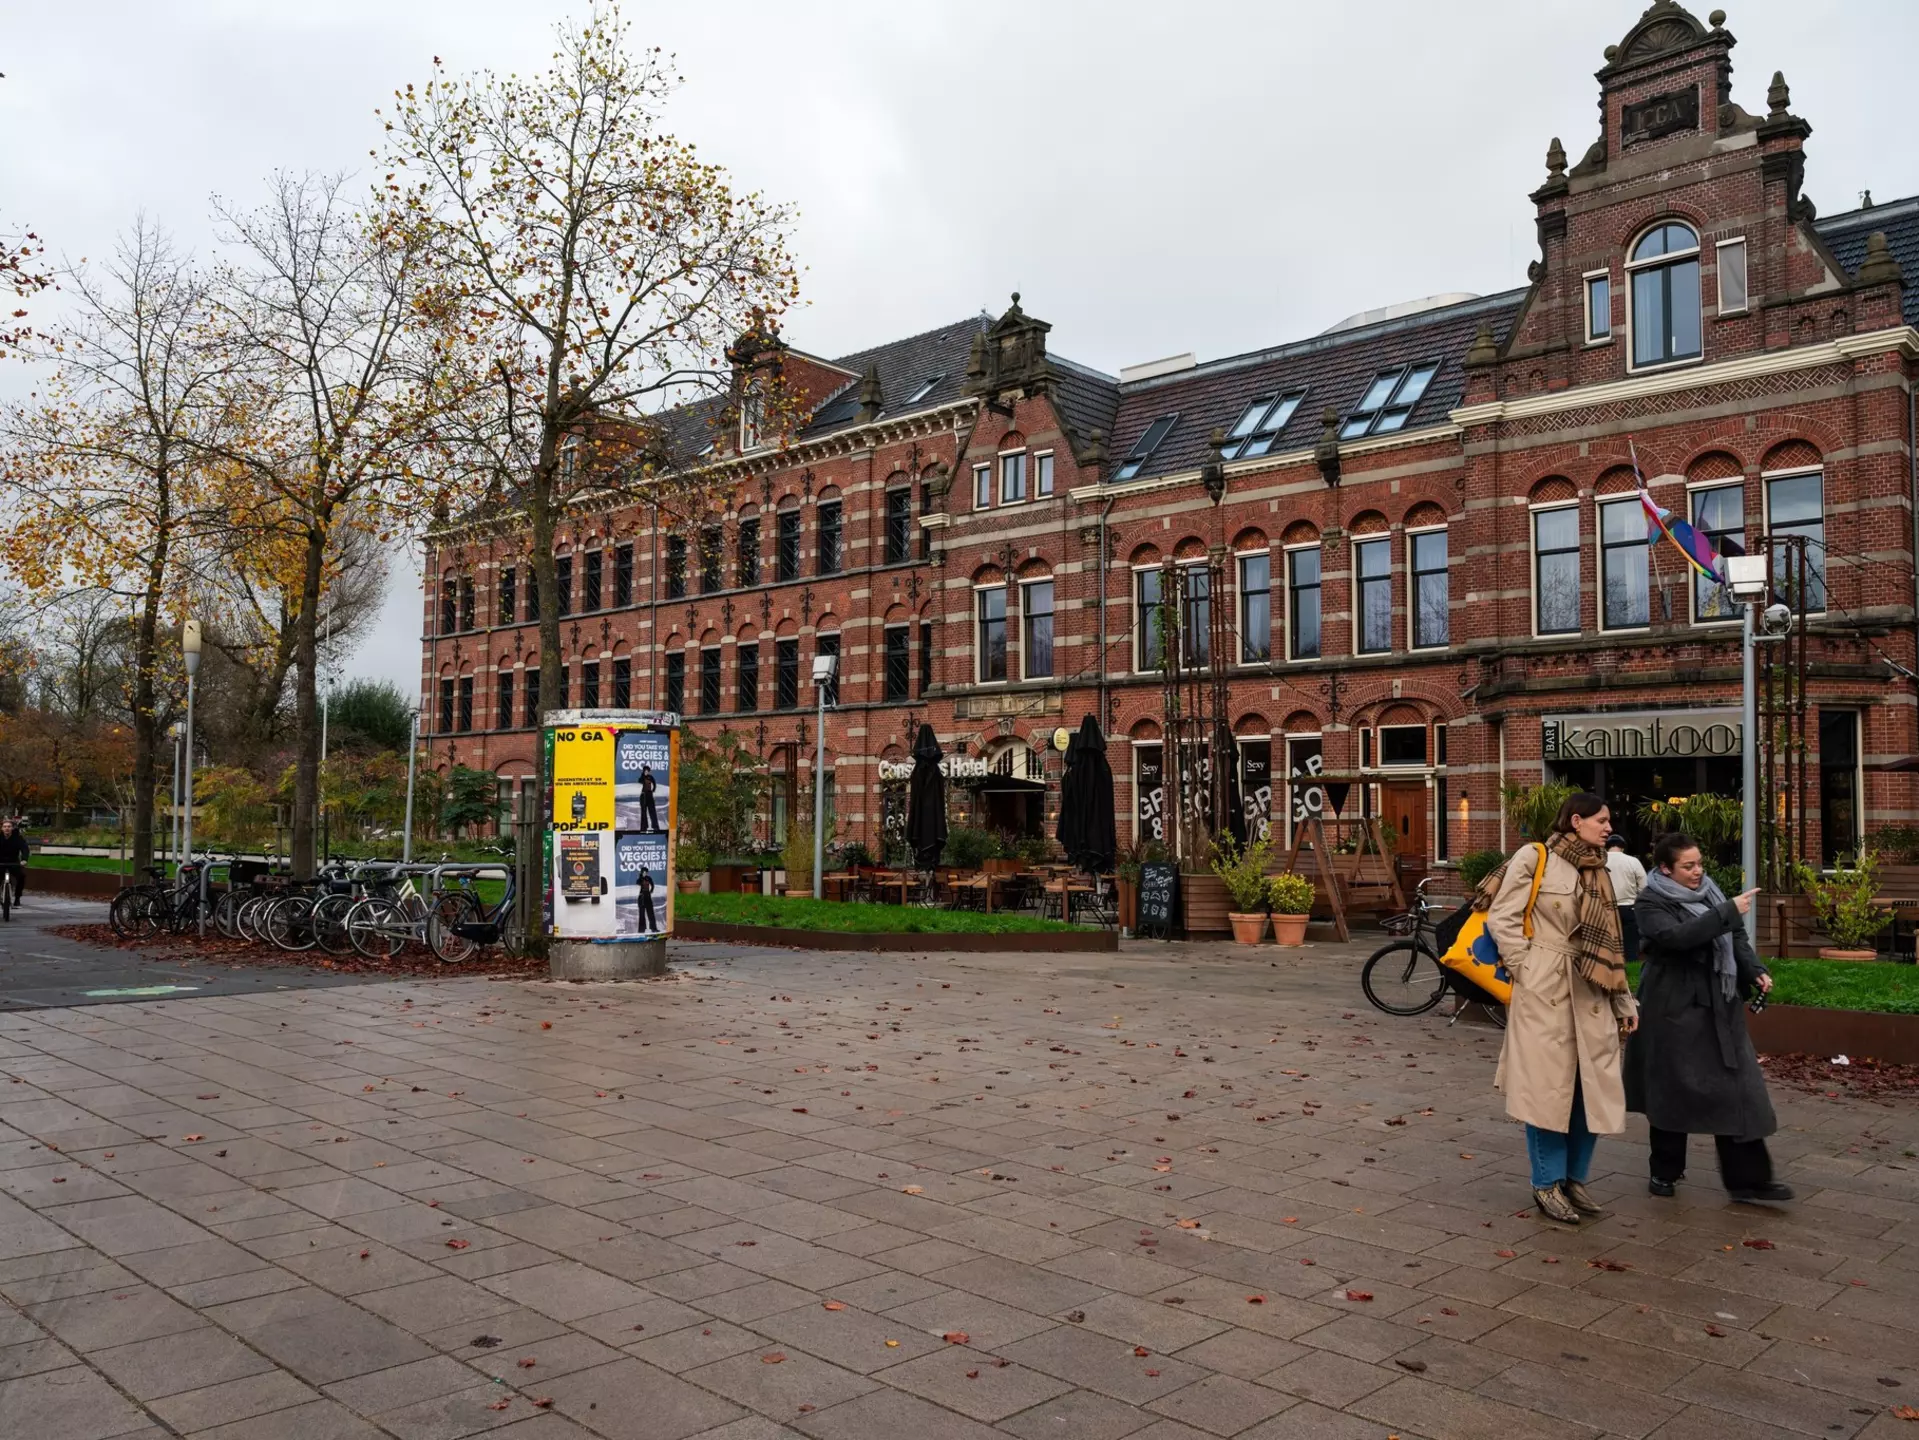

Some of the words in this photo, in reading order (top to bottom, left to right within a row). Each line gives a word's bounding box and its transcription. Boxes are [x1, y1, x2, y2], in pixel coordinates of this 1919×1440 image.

[557, 731, 575, 742] NO
[581, 731, 604, 741] GA
[1545, 728, 1555, 751] BAR
[620, 750, 662, 760] VEGGIES
[663, 751, 669, 760] &
[621, 760, 669, 770] COCAINE?
[949, 757, 988, 777] Hotel
[1142, 763, 1158, 773] Sexy
[1246, 759, 1265, 770] Sexy
[1293, 786, 1322, 823] GO
[553, 822, 609, 832] POP-UP
[619, 851, 660, 861] VEGGIES
[661, 851, 667, 860] &
[620, 861, 667, 872] COCAINE?
